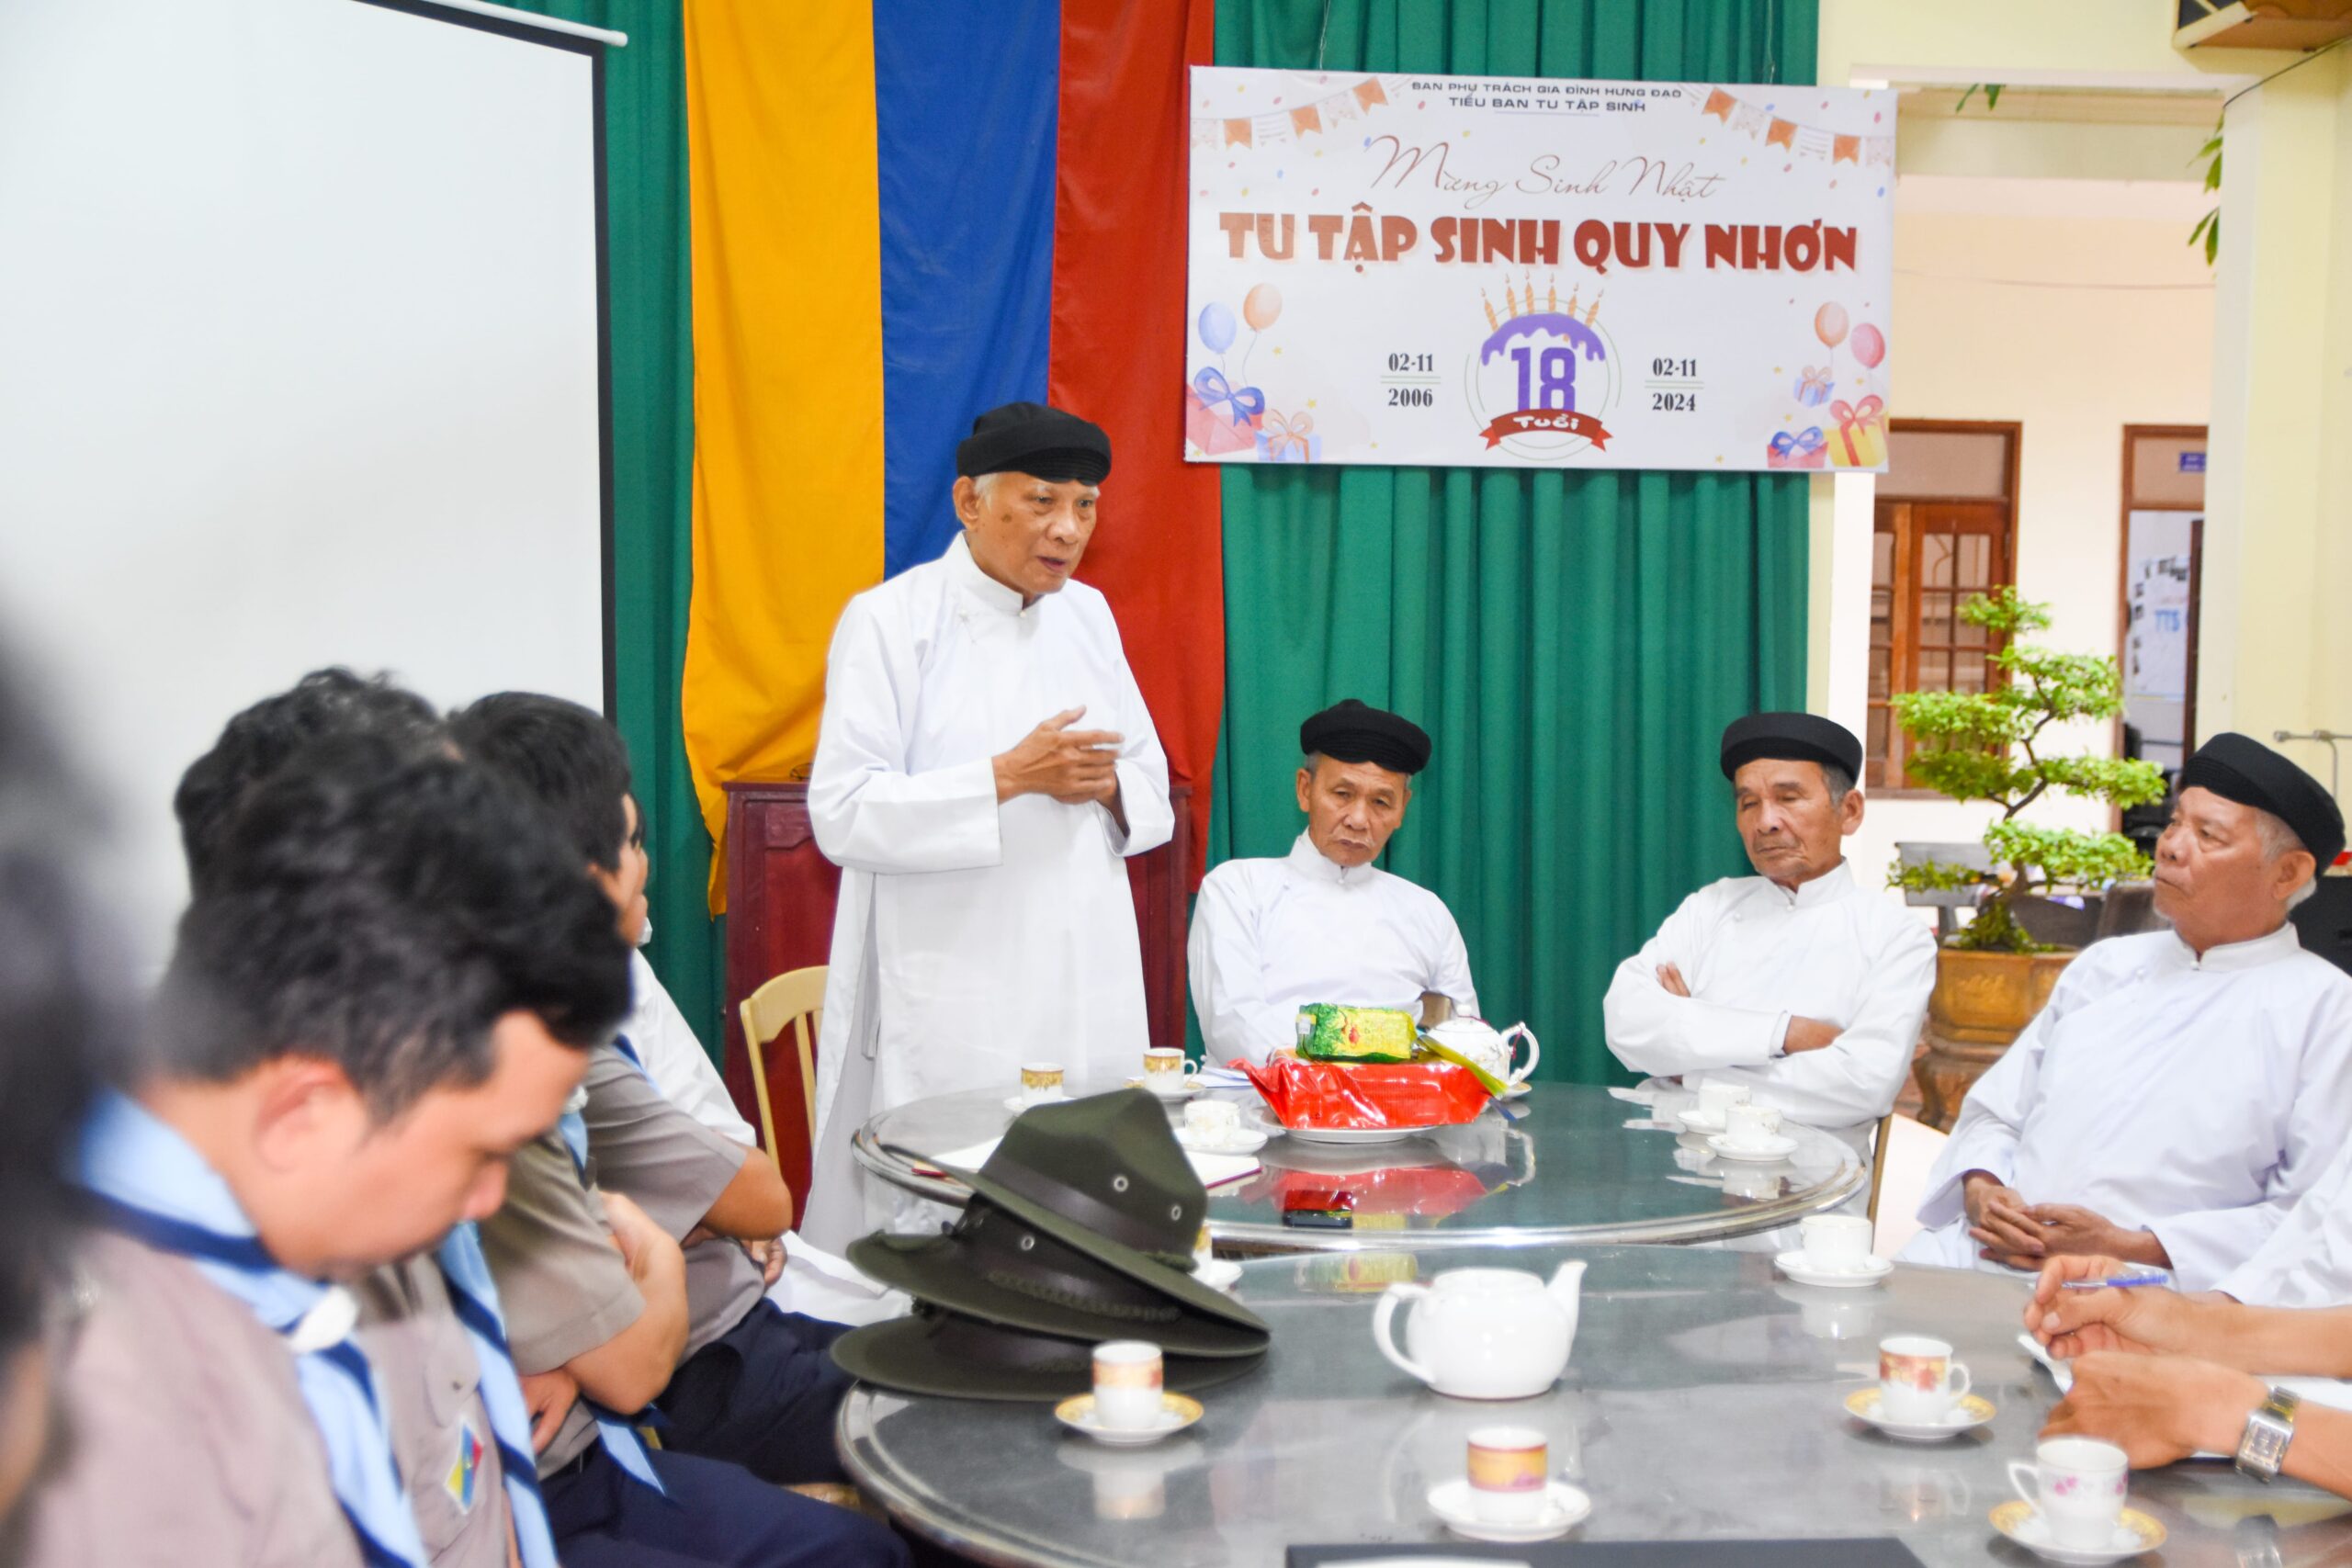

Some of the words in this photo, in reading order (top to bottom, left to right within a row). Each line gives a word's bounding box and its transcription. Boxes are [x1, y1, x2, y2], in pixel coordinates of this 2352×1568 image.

[1412, 81, 1443, 91] BAN
[1483, 81, 1532, 93] TRÁCH
[1537, 85, 1560, 95] GIA
[1566, 84, 1600, 96] ĐÌNH
[1605, 86, 1646, 96] HƯNG
[1651, 88, 1682, 99] ĐẠO
[1448, 92, 1486, 107] TIỂU
[1492, 98, 1529, 108] BAN
[1536, 99, 1558, 109] TU
[1566, 97, 1600, 112] TẬP
[1606, 101, 1646, 112] SINH
[1364, 134, 1507, 210] Mừng
[1515, 154, 1617, 196] Sinh
[1621, 155, 1727, 203] Nhật
[1219, 212, 1295, 261] TU
[1308, 201, 1419, 273] TẬP
[1430, 215, 1561, 266] SINH
[1573, 219, 1691, 276] QUY
[1704, 218, 1858, 273] NHƠN
[1387, 353, 1434, 373] 02-11
[1652, 357, 1698, 378] 02-11
[1510, 346, 1577, 412] 18
[1387, 388, 1434, 408] 2006
[1652, 392, 1697, 412] 2024
[1512, 412, 1580, 431] Tuổi
